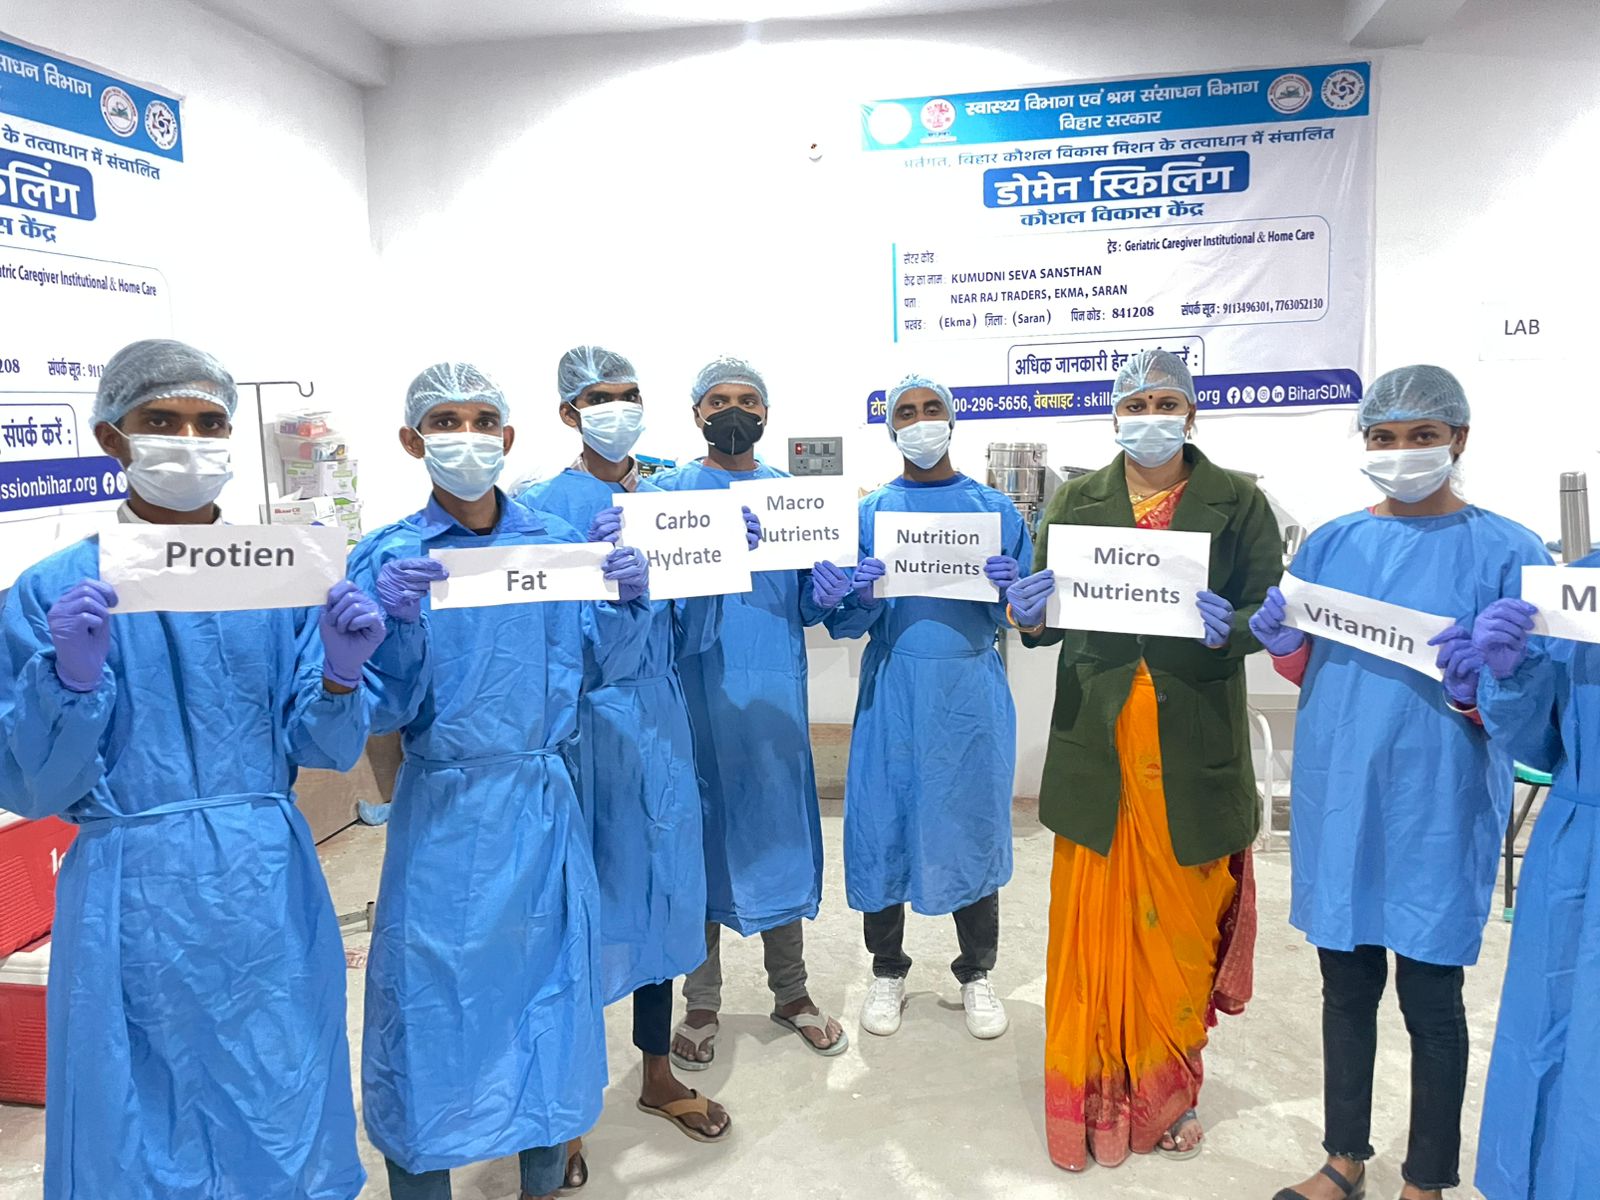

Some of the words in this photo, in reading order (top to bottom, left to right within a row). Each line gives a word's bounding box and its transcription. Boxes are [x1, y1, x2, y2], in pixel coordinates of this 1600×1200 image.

[43, 62, 92, 98] विभाग
[1025, 92, 1074, 111] विभाग
[1079, 88, 1105, 106] एवं
[1106, 90, 1136, 105] श्रम
[1140, 84, 1202, 103] संसाधन
[1207, 78, 1260, 97] विभाग
[1106, 110, 1162, 128] सरकार
[2, 124, 20, 144] के
[23, 133, 88, 162] तत्वाधान
[91, 147, 104, 166] में
[105, 153, 160, 180] संचालित
[1003, 148, 1051, 163] कौशल
[1058, 143, 1108, 160] विकास
[1113, 141, 1155, 155] मिशन
[1159, 138, 1175, 151] के
[1180, 134, 1246, 150] तत्वाधान
[1251, 131, 1264, 145] में
[1268, 127, 1335, 143] संचालित
[994, 172, 1082, 206] डोमेन
[1089, 155, 1234, 199] स्किलिंग
[1020, 205, 1086, 226] कौशल
[1091, 205, 1162, 222] विकास
[1166, 200, 1204, 217] केंद्र
[18, 214, 57, 243] केंद्र
[1125, 237, 1160, 251] Geriatric
[1162, 235, 1201, 251] Caregiver
[1203, 232, 1255, 247] Institutional
[1256, 232, 1266, 243] &
[1267, 231, 1294, 243] Home
[1295, 228, 1315, 241] Care
[18, 265, 59, 286] Caregiver
[60, 270, 108, 291] Institutional
[109, 277, 117, 291] &
[118, 278, 140, 294] Home
[141, 281, 157, 296] Care
[952, 271, 1005, 284] KUMUDNI
[1008, 269, 1037, 281] SEVA
[1040, 265, 1102, 279] SANSTHAN
[951, 294, 977, 304] NEAR
[980, 292, 998, 303] RAJ
[1001, 289, 1051, 302] TRADERS,
[1054, 287, 1089, 300] EKMA,
[1092, 285, 1128, 297] SARAN
[1275, 298, 1323, 311] 7763052130
[1071, 308, 1085, 322] पिन
[1112, 306, 1154, 319] 841208
[1181, 301, 1200, 316] संपर्क
[1504, 319, 1541, 335] LAB
[47, 357, 67, 376] संपर्क
[1015, 354, 1053, 375] अधिक
[1055, 349, 1108, 373] जानकारी
[1288, 384, 1351, 401] BiharSDM
[1, 416, 38, 448] संपर्क
[767, 495, 825, 511] Macro
[655, 510, 711, 530] Carbo
[760, 525, 840, 544] Nutrients
[896, 529, 980, 545] Nutrition
[166, 540, 295, 567] Protien
[647, 547, 722, 570] Hydrate
[1094, 547, 1160, 567] Micro
[894, 559, 980, 576] Nutrients
[507, 570, 548, 592] Fat
[1073, 581, 1181, 604] Nutrients
[1562, 584, 1598, 613] M
[1304, 603, 1415, 654] Vitamin
